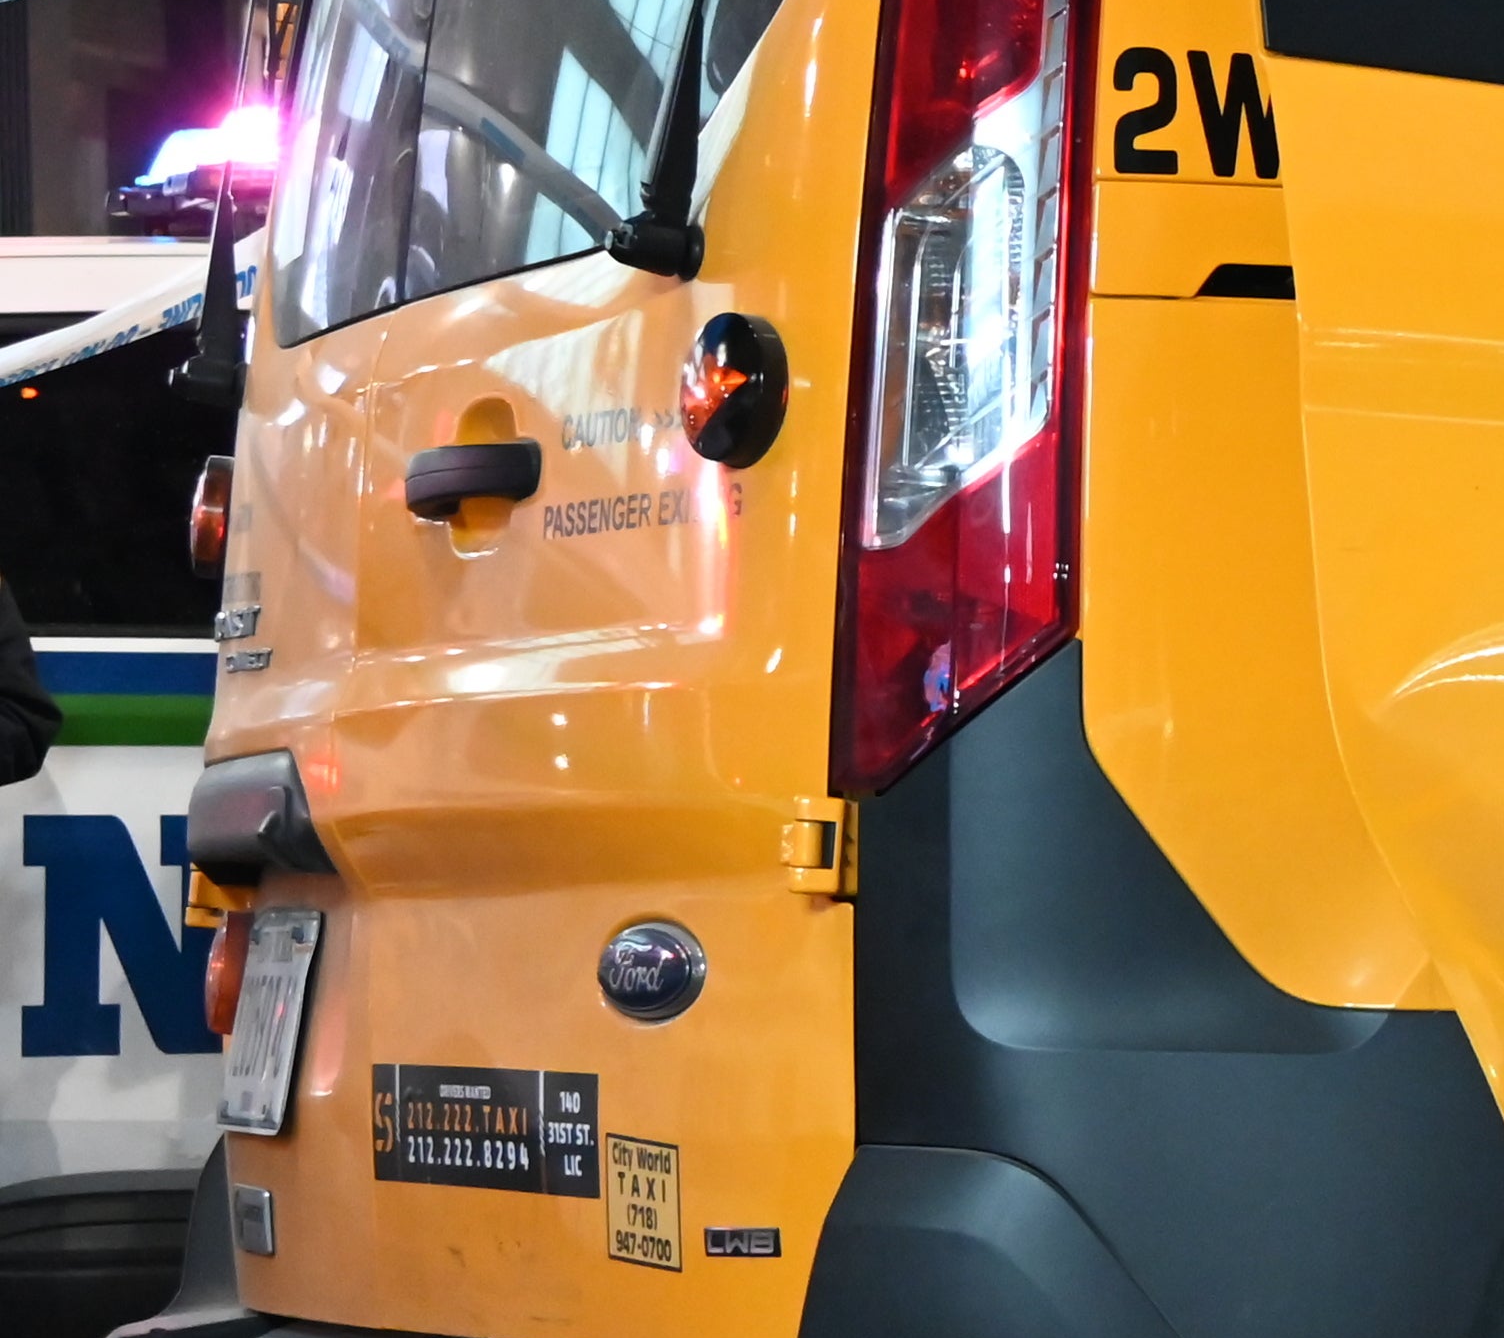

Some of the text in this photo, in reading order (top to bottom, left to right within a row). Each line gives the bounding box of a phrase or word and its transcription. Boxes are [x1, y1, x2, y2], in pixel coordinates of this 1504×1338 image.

[561, 408, 642, 451] CAUTION
[543, 482, 744, 541] PASSENGER EXIG
[608, 942, 664, 992] Ford
[406, 1102, 529, 1136] 212.222.TAXI
[559, 1091, 581, 1114] 140
[547, 1121, 595, 1147] 31ST ST.
[407, 1135, 530, 1172] 212.222.8294
[563, 1154, 583, 1177] LIC
[612, 1141, 672, 1175] City World
[626, 1203, 658, 1231] (718)
[615, 1229, 672, 1263] 947-0700
[706, 1228, 775, 1255] LWB
